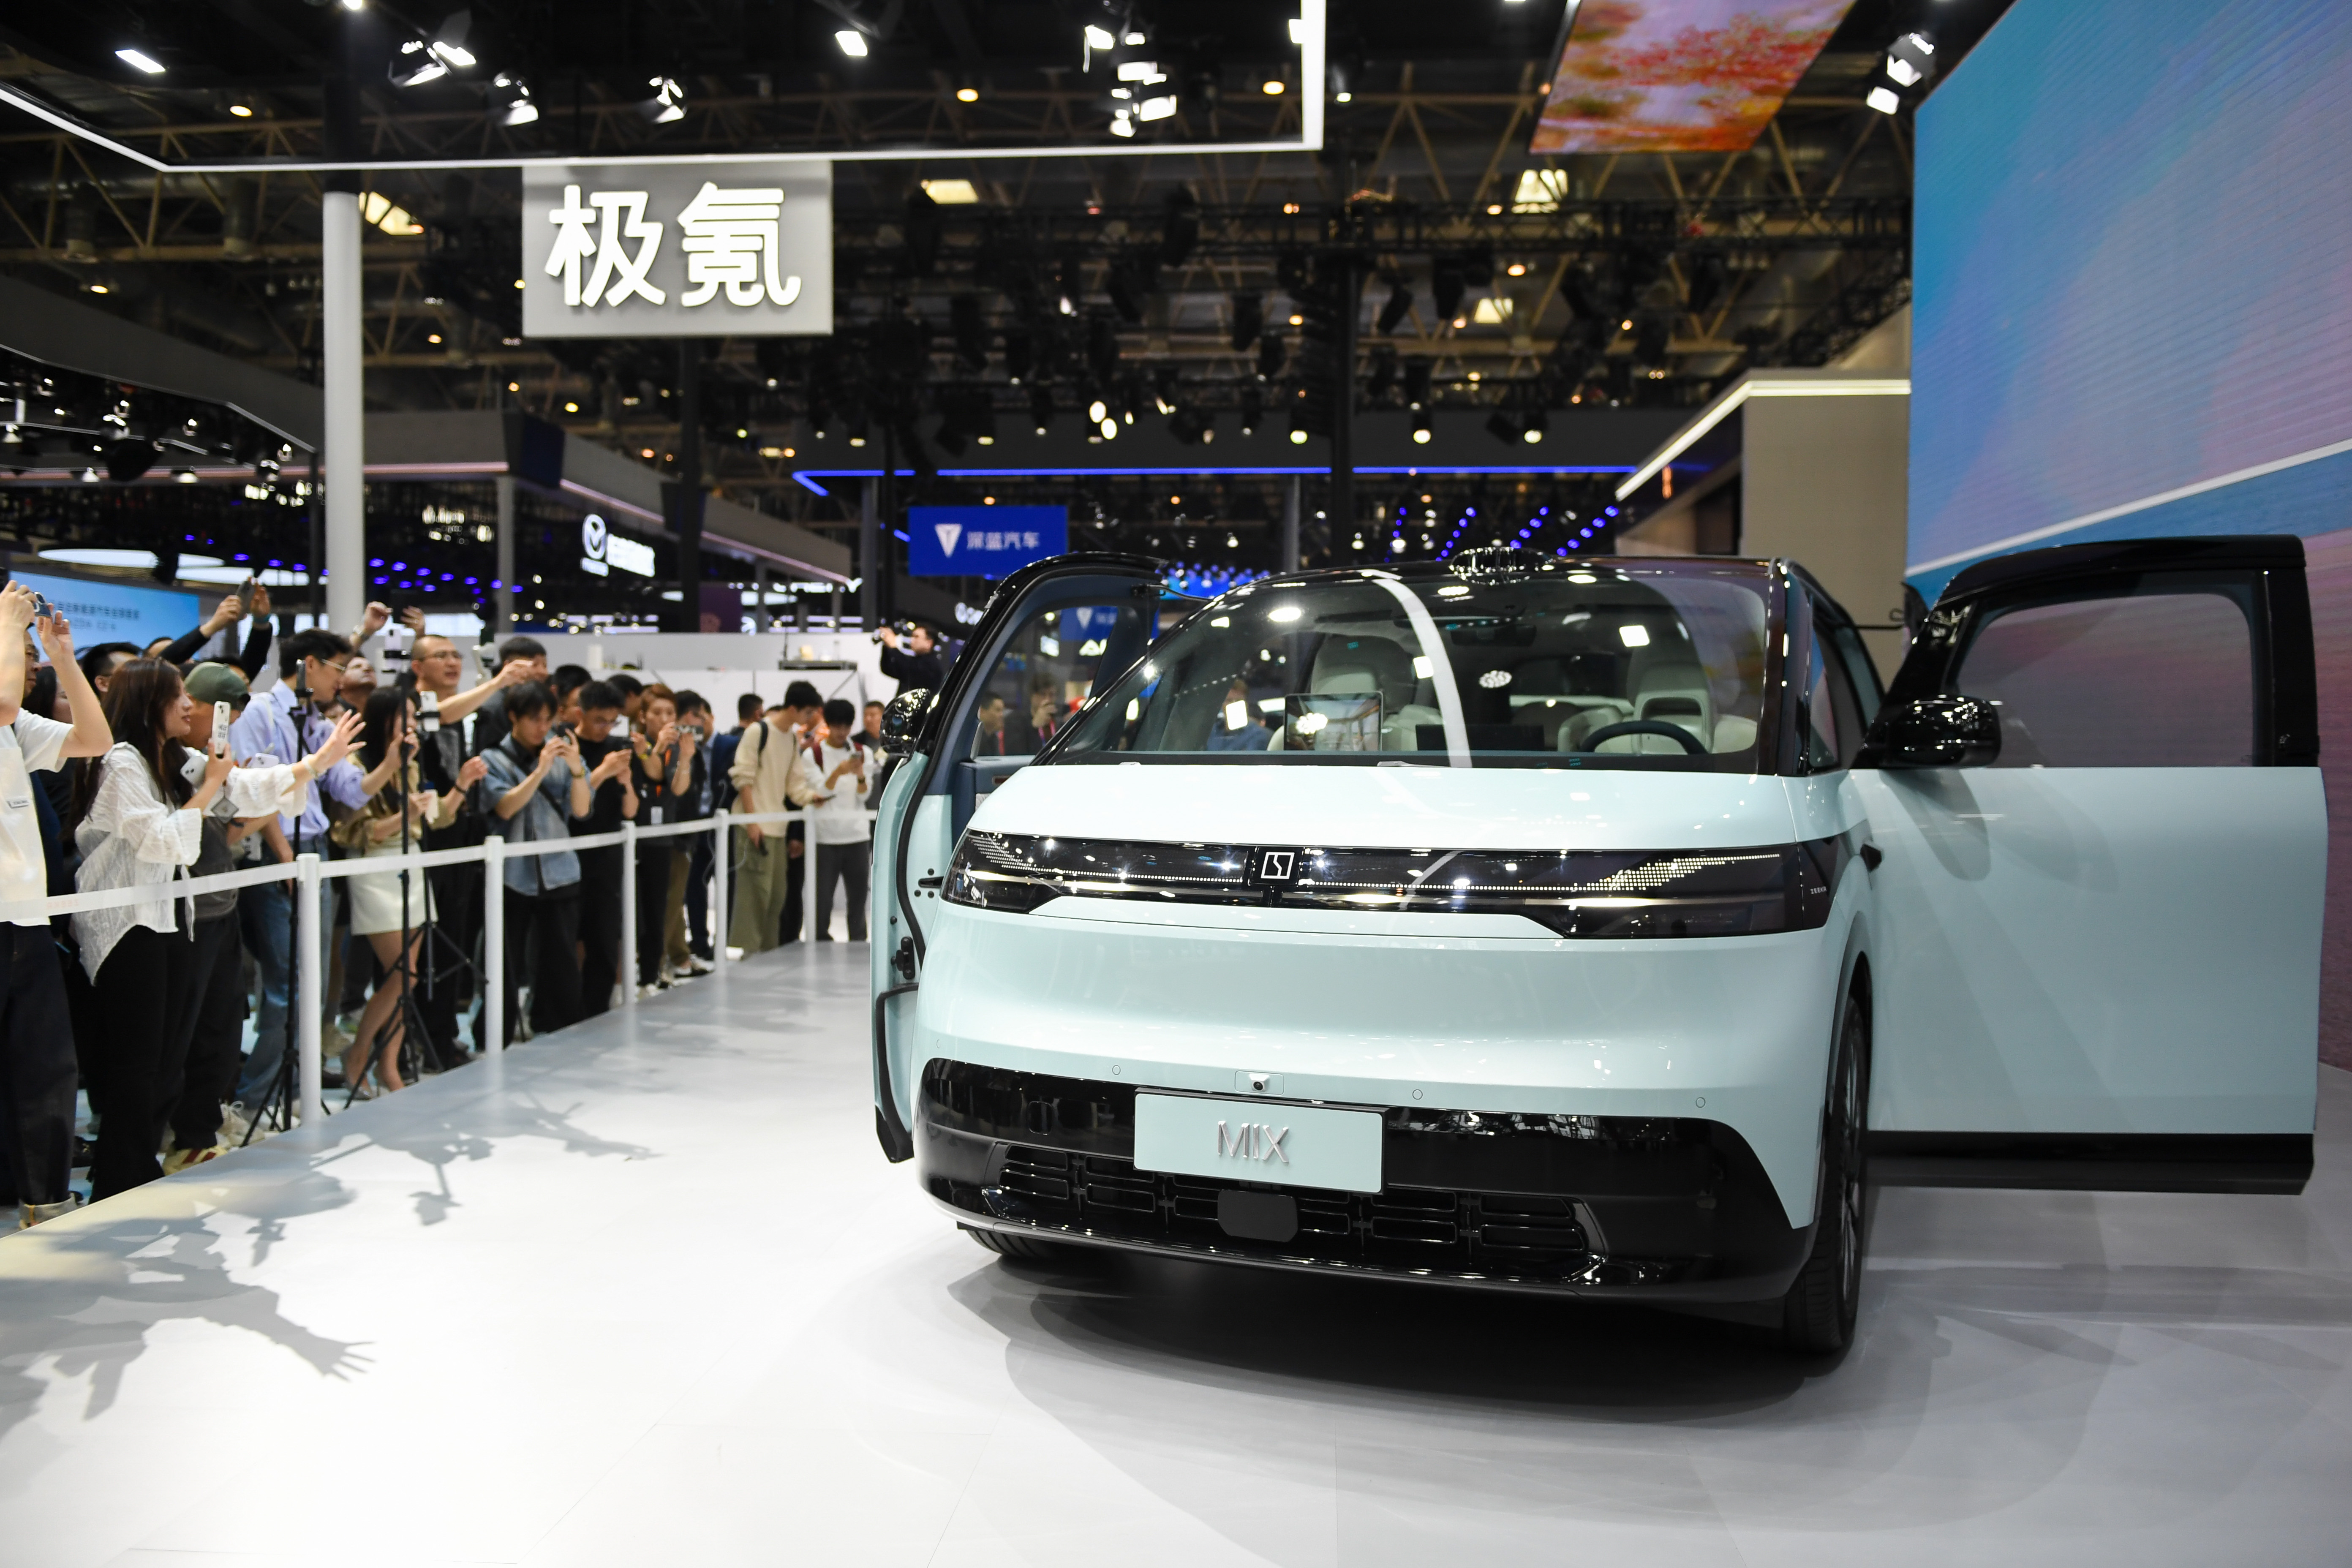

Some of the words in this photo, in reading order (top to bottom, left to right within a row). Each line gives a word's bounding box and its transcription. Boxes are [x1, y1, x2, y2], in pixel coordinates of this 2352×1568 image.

[544, 181, 802, 308] 极氪
[1810, 886, 1827, 894] ZEEKR
[1217, 1120, 1290, 1163] MIX
